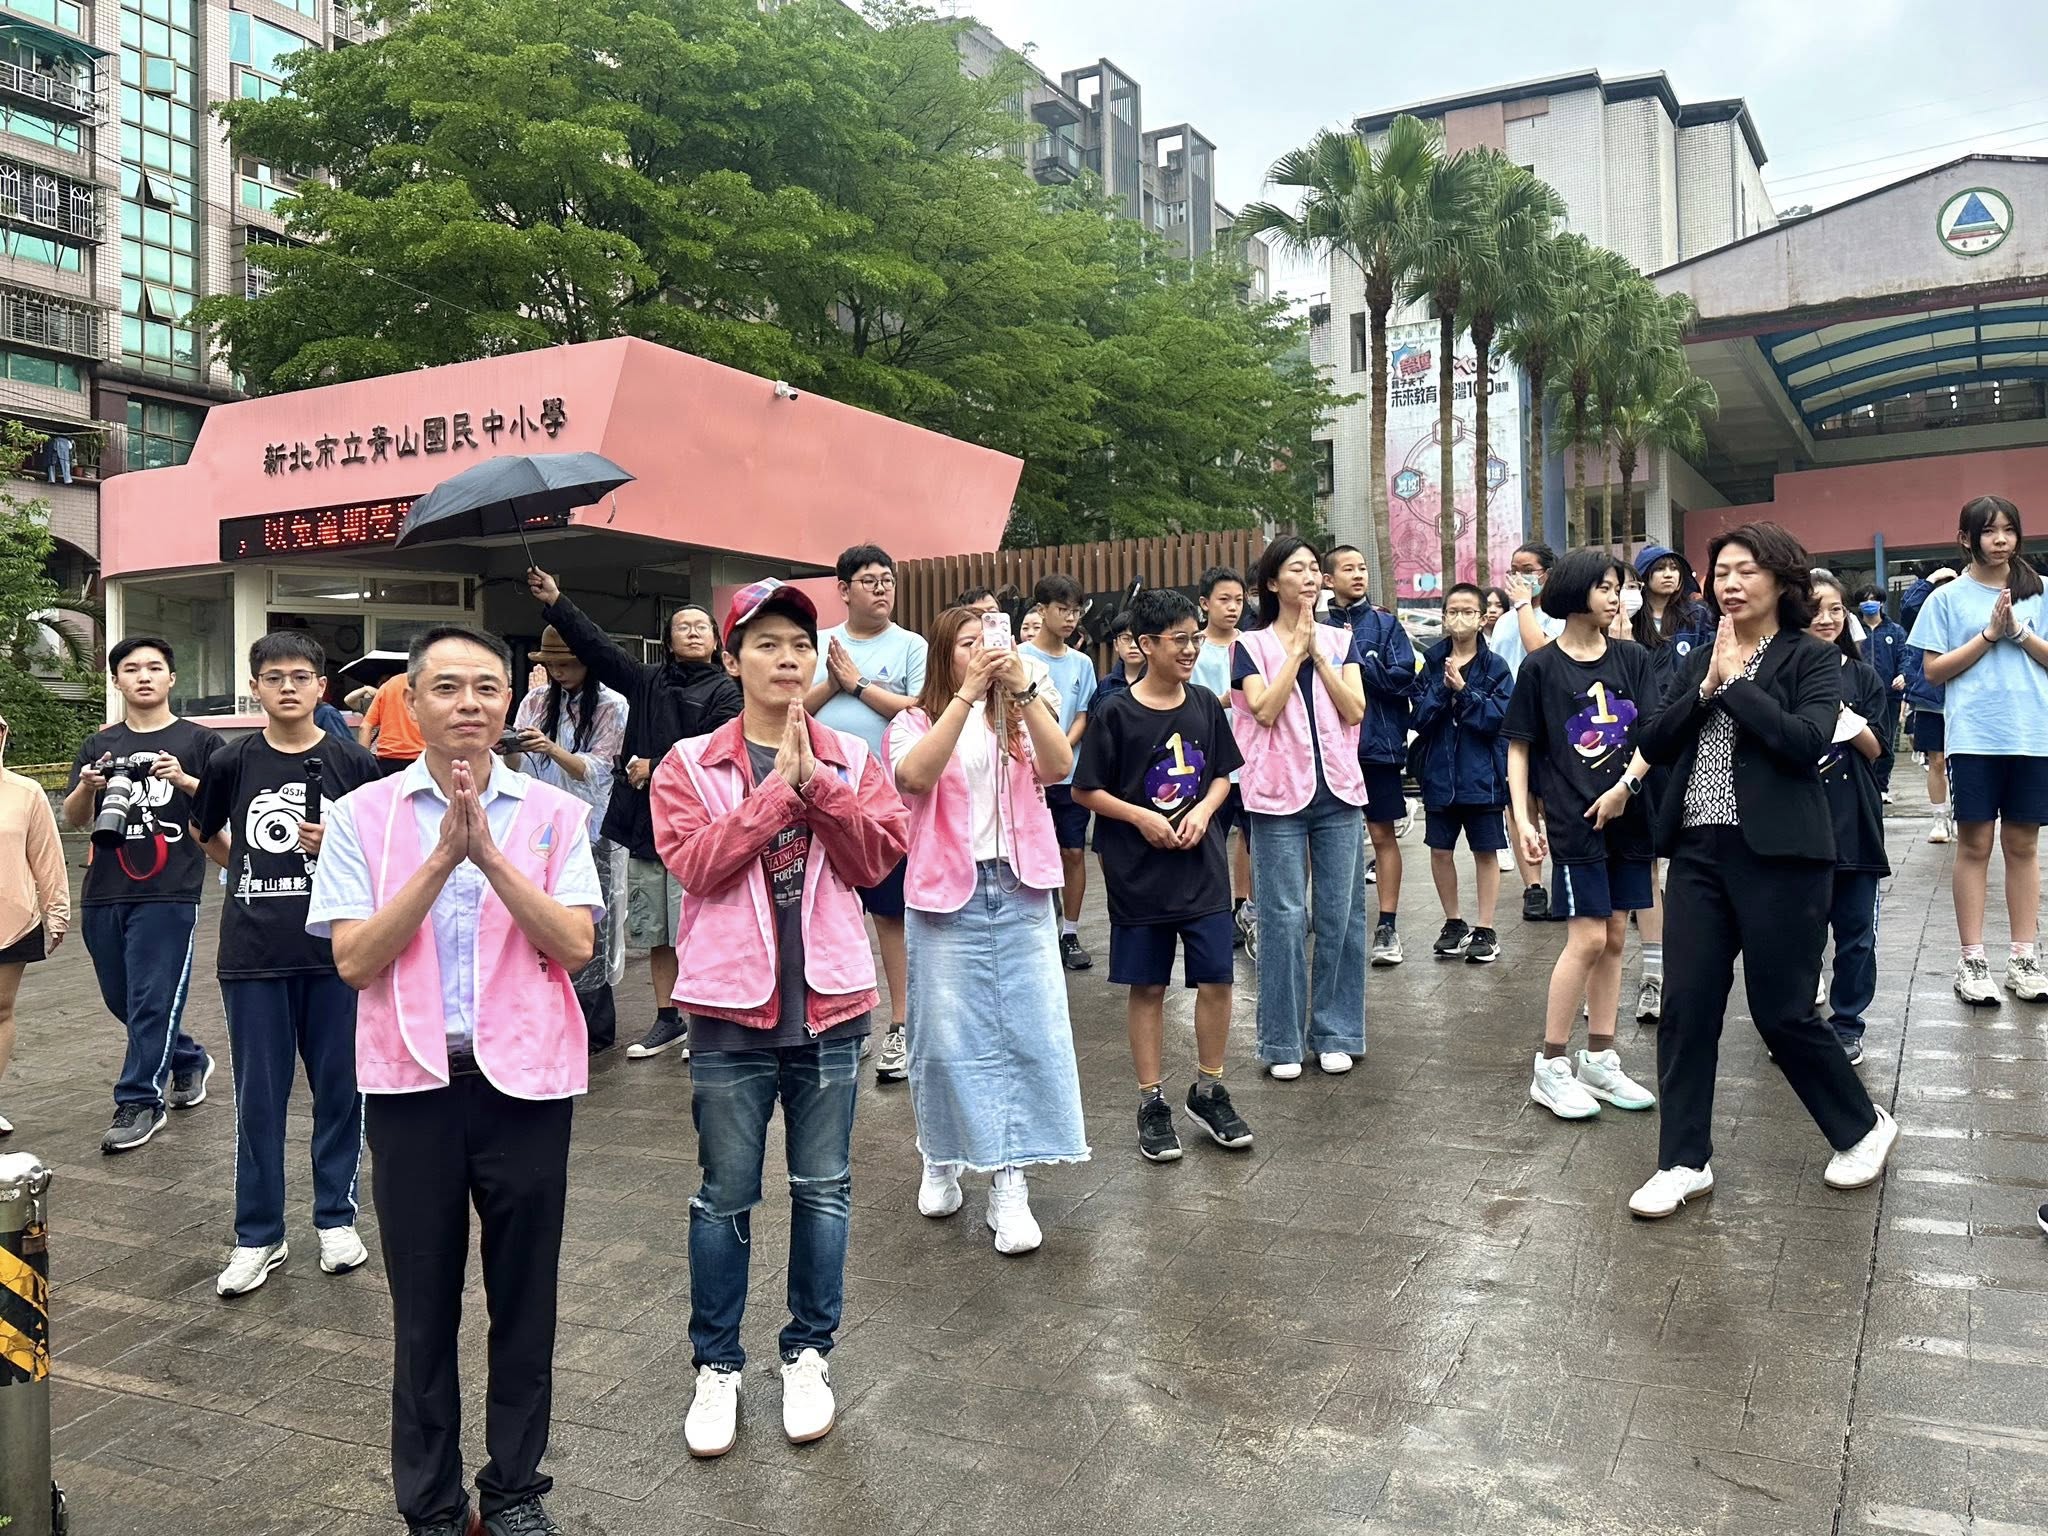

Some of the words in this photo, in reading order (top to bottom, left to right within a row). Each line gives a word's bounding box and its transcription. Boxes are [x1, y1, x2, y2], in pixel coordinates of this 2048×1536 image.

[263, 397, 568, 477] 新北市立青山國民中小學
[1587, 681, 1618, 724] 1
[1165, 732, 1196, 776] 1
[282, 787, 307, 798] QSJH
[250, 876, 308, 892] 青山攝影
